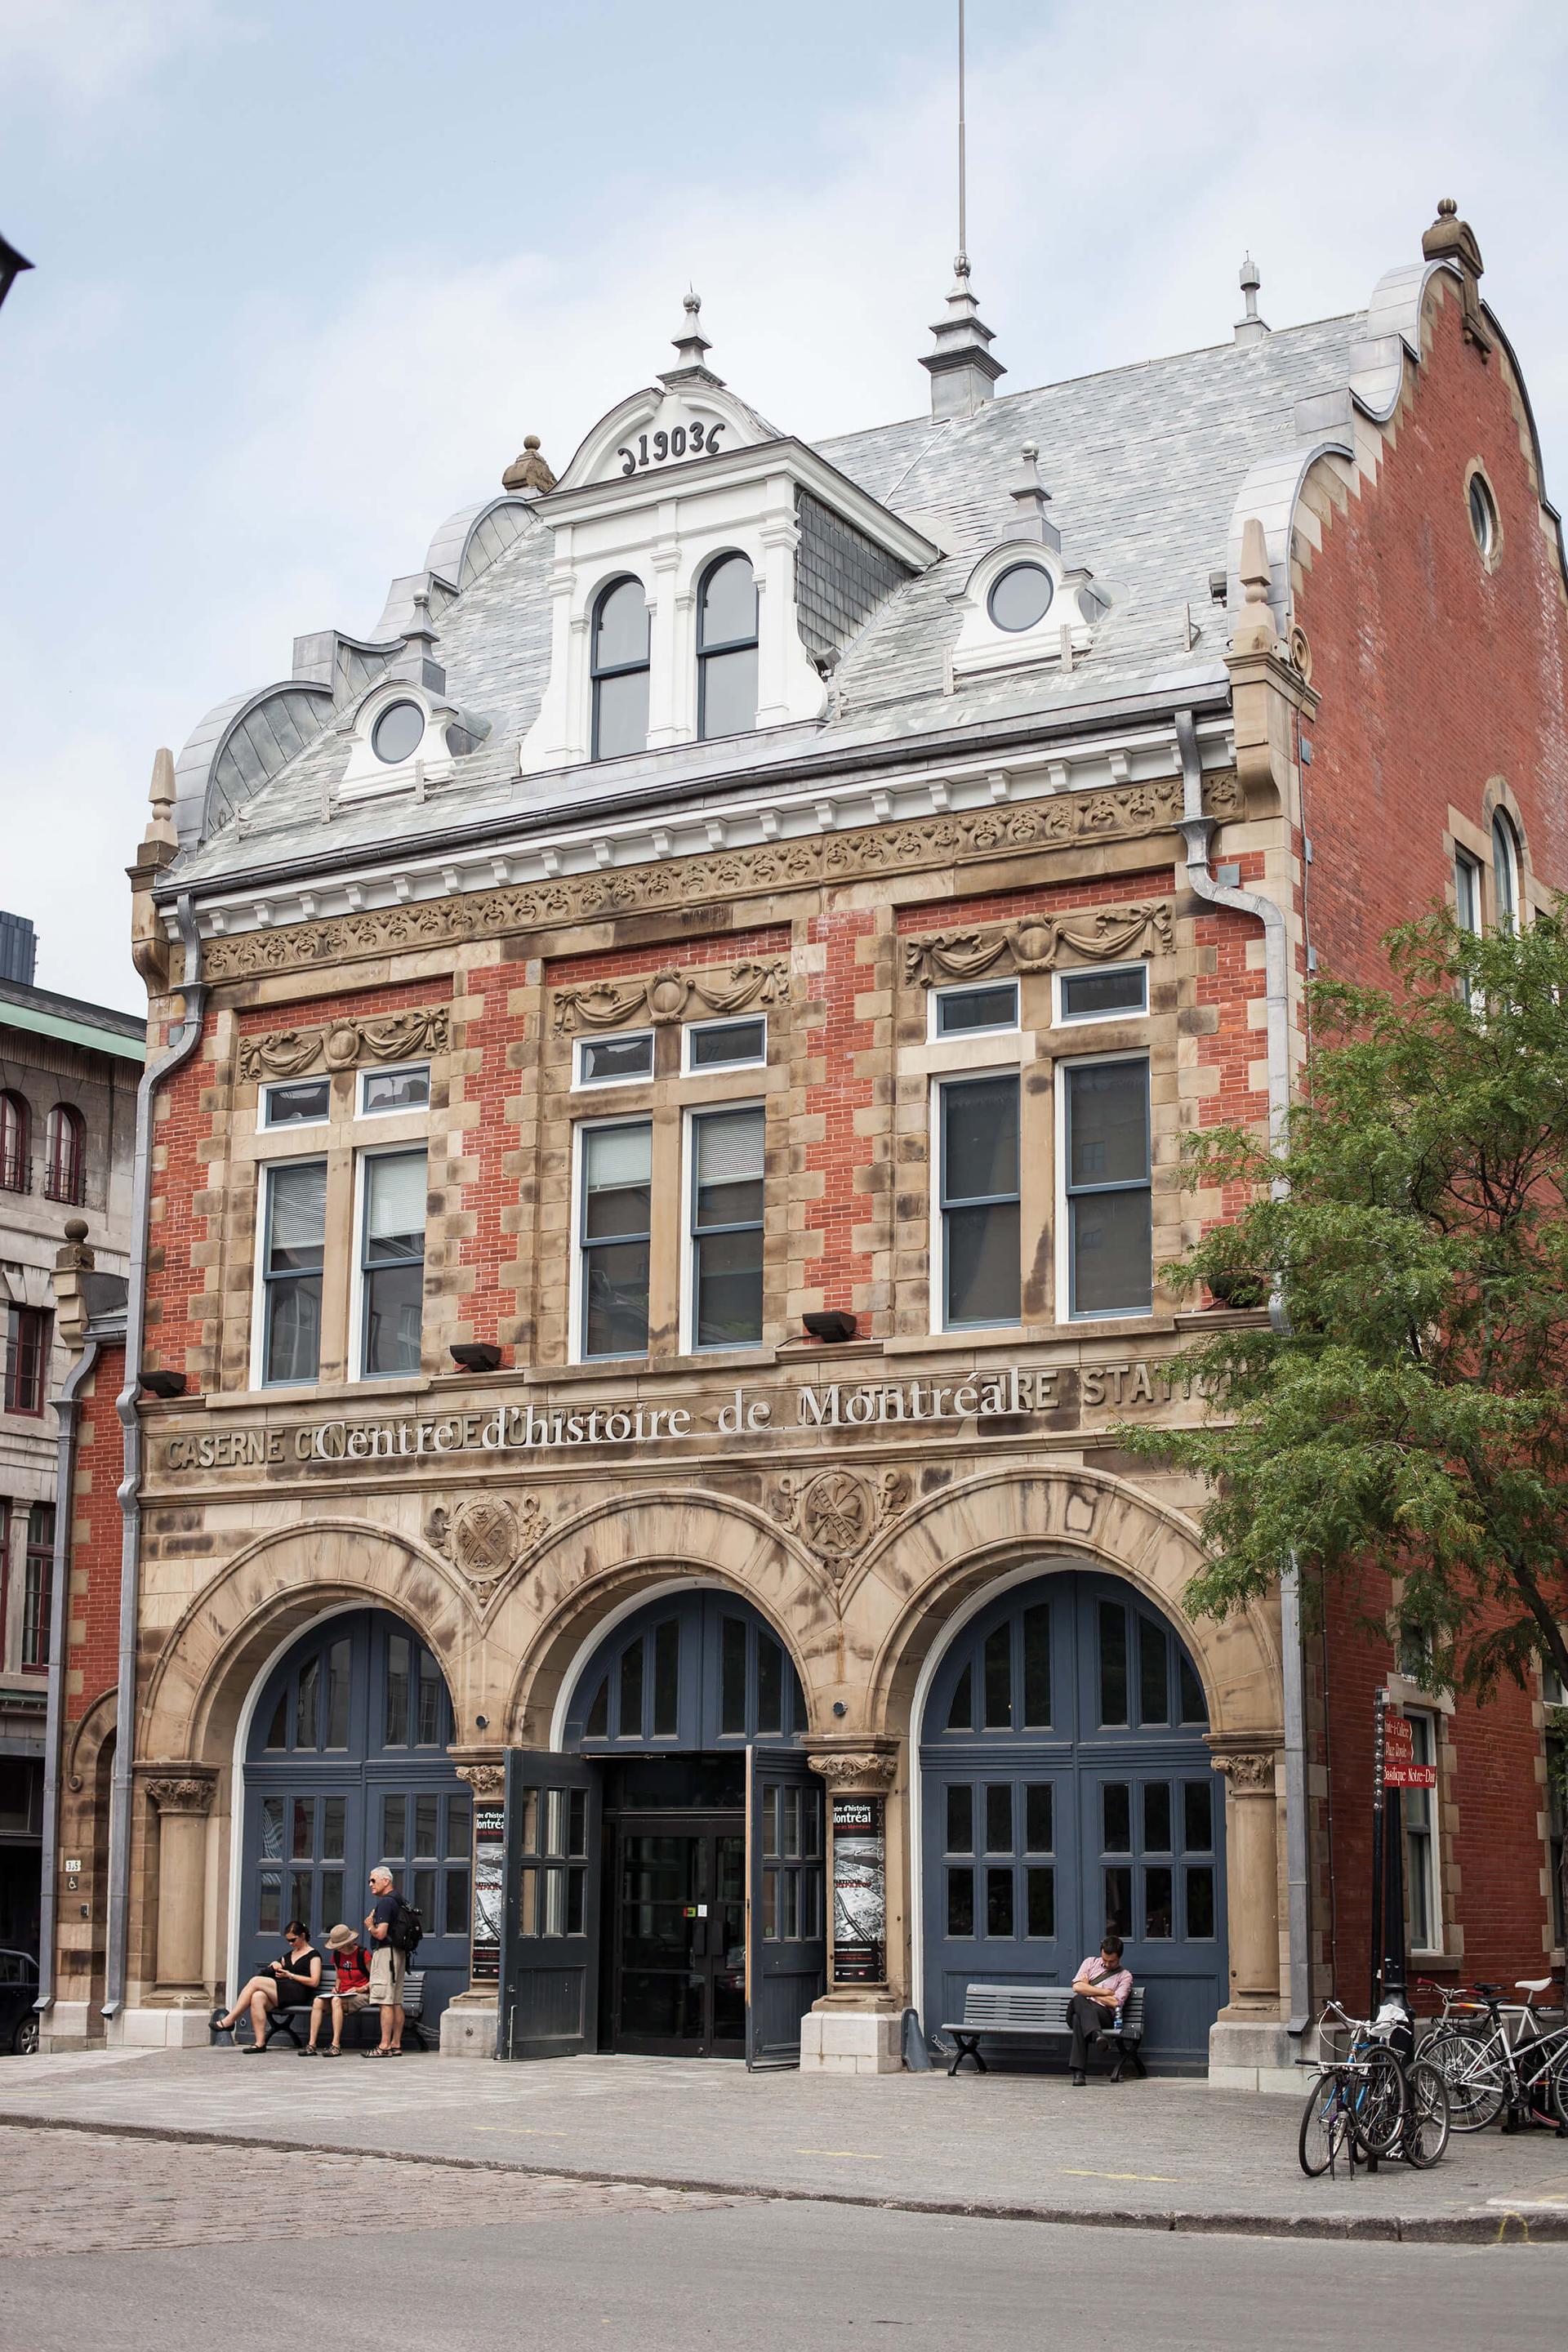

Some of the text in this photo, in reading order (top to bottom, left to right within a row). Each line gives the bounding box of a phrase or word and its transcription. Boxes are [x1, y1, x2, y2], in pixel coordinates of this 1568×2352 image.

[638, 421, 705, 466] 1903
[315, 1366, 1031, 1460] Centre d'histoire de Montréal
[166, 1429, 285, 1469] CASERNE
